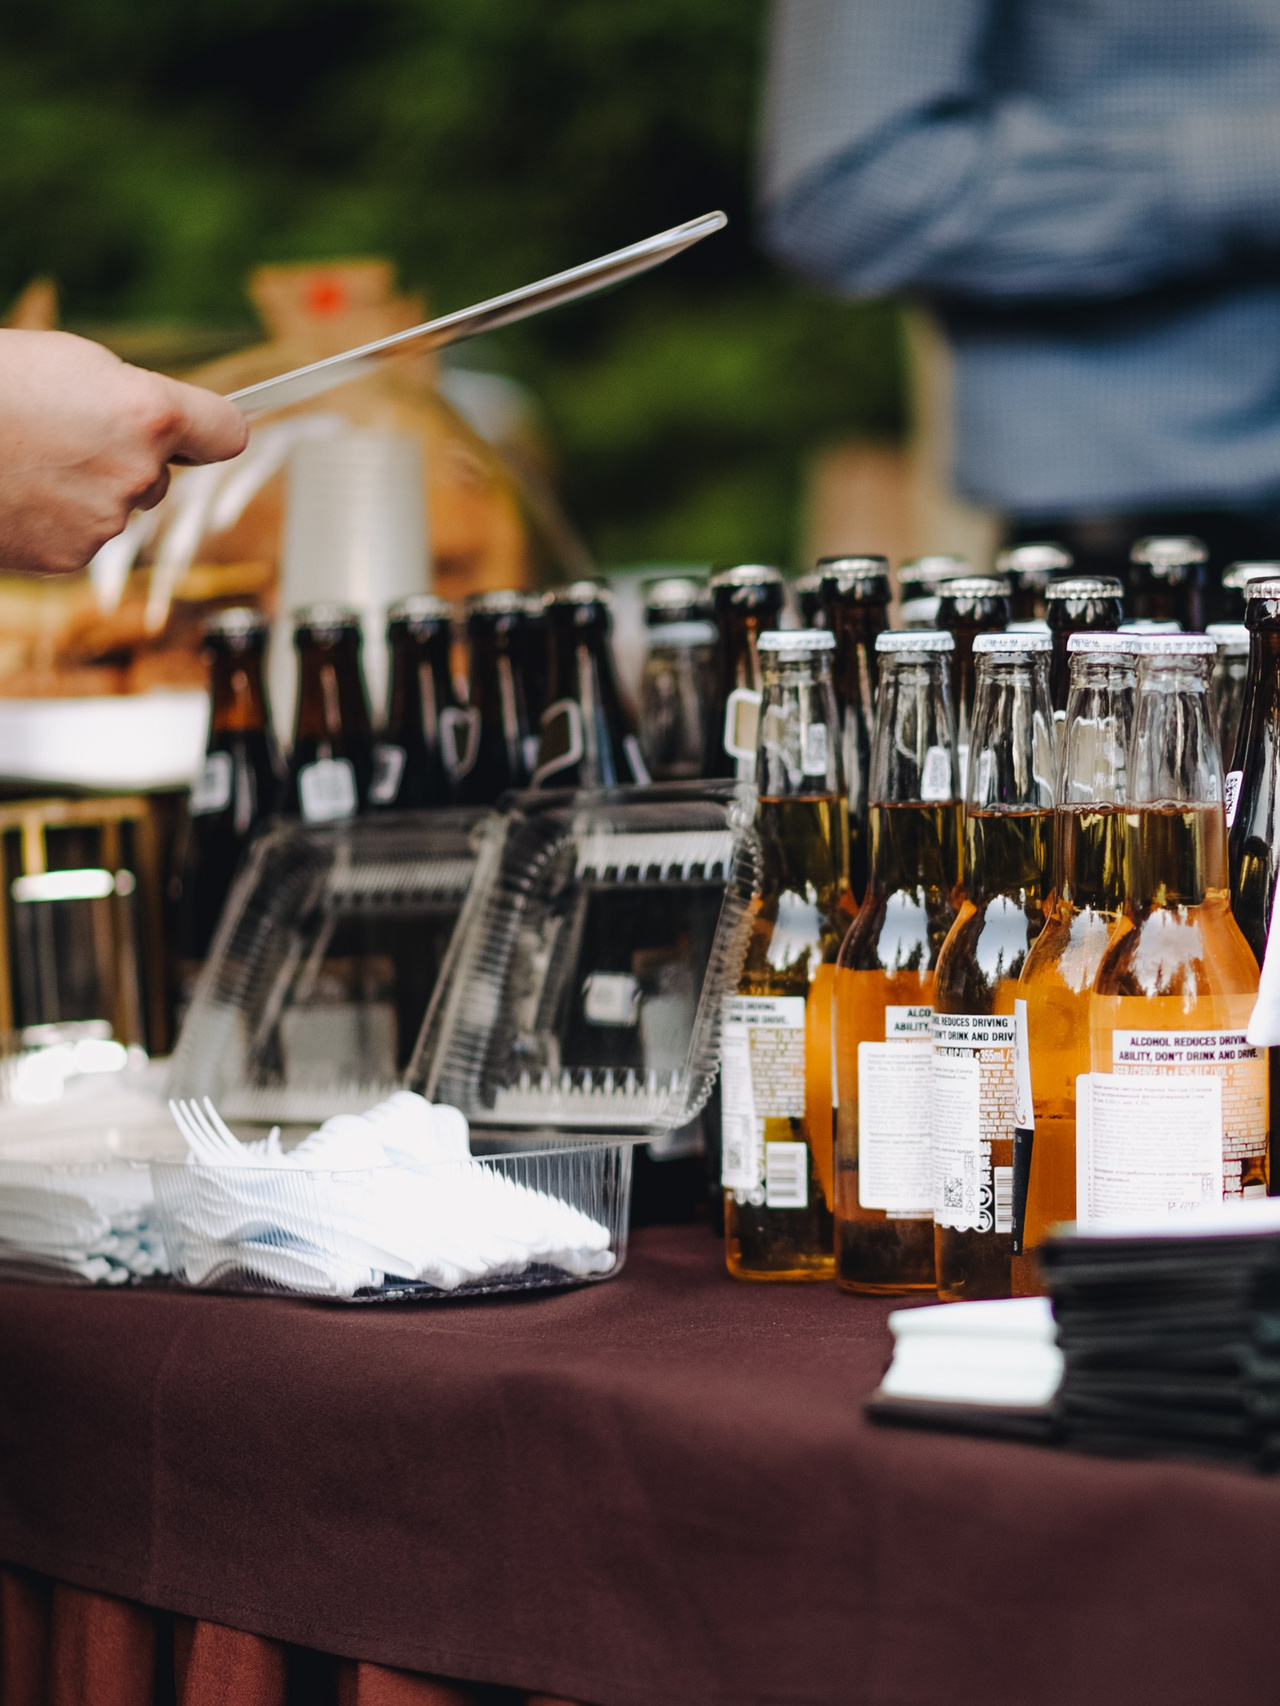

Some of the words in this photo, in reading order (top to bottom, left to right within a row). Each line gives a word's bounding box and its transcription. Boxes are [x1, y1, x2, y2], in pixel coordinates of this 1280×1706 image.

[908, 1008, 931, 1018] ALCO
[941, 1016, 970, 1027] REDUCES
[972, 1018, 1008, 1028] DRIVING
[948, 1031, 969, 1041] DRINK
[971, 1032, 989, 1041] AND
[992, 1032, 1014, 1041] DRIV
[1130, 1036, 1171, 1047] ALCOHOL
[1174, 1036, 1216, 1047] REDUCES
[1219, 1035, 1248, 1046] DRIVIN
[1119, 1052, 1153, 1063] ABILITY,
[1155, 1051, 1183, 1062] DON'T
[1186, 1051, 1216, 1061] DRINK
[1218, 1050, 1236, 1060] AND
